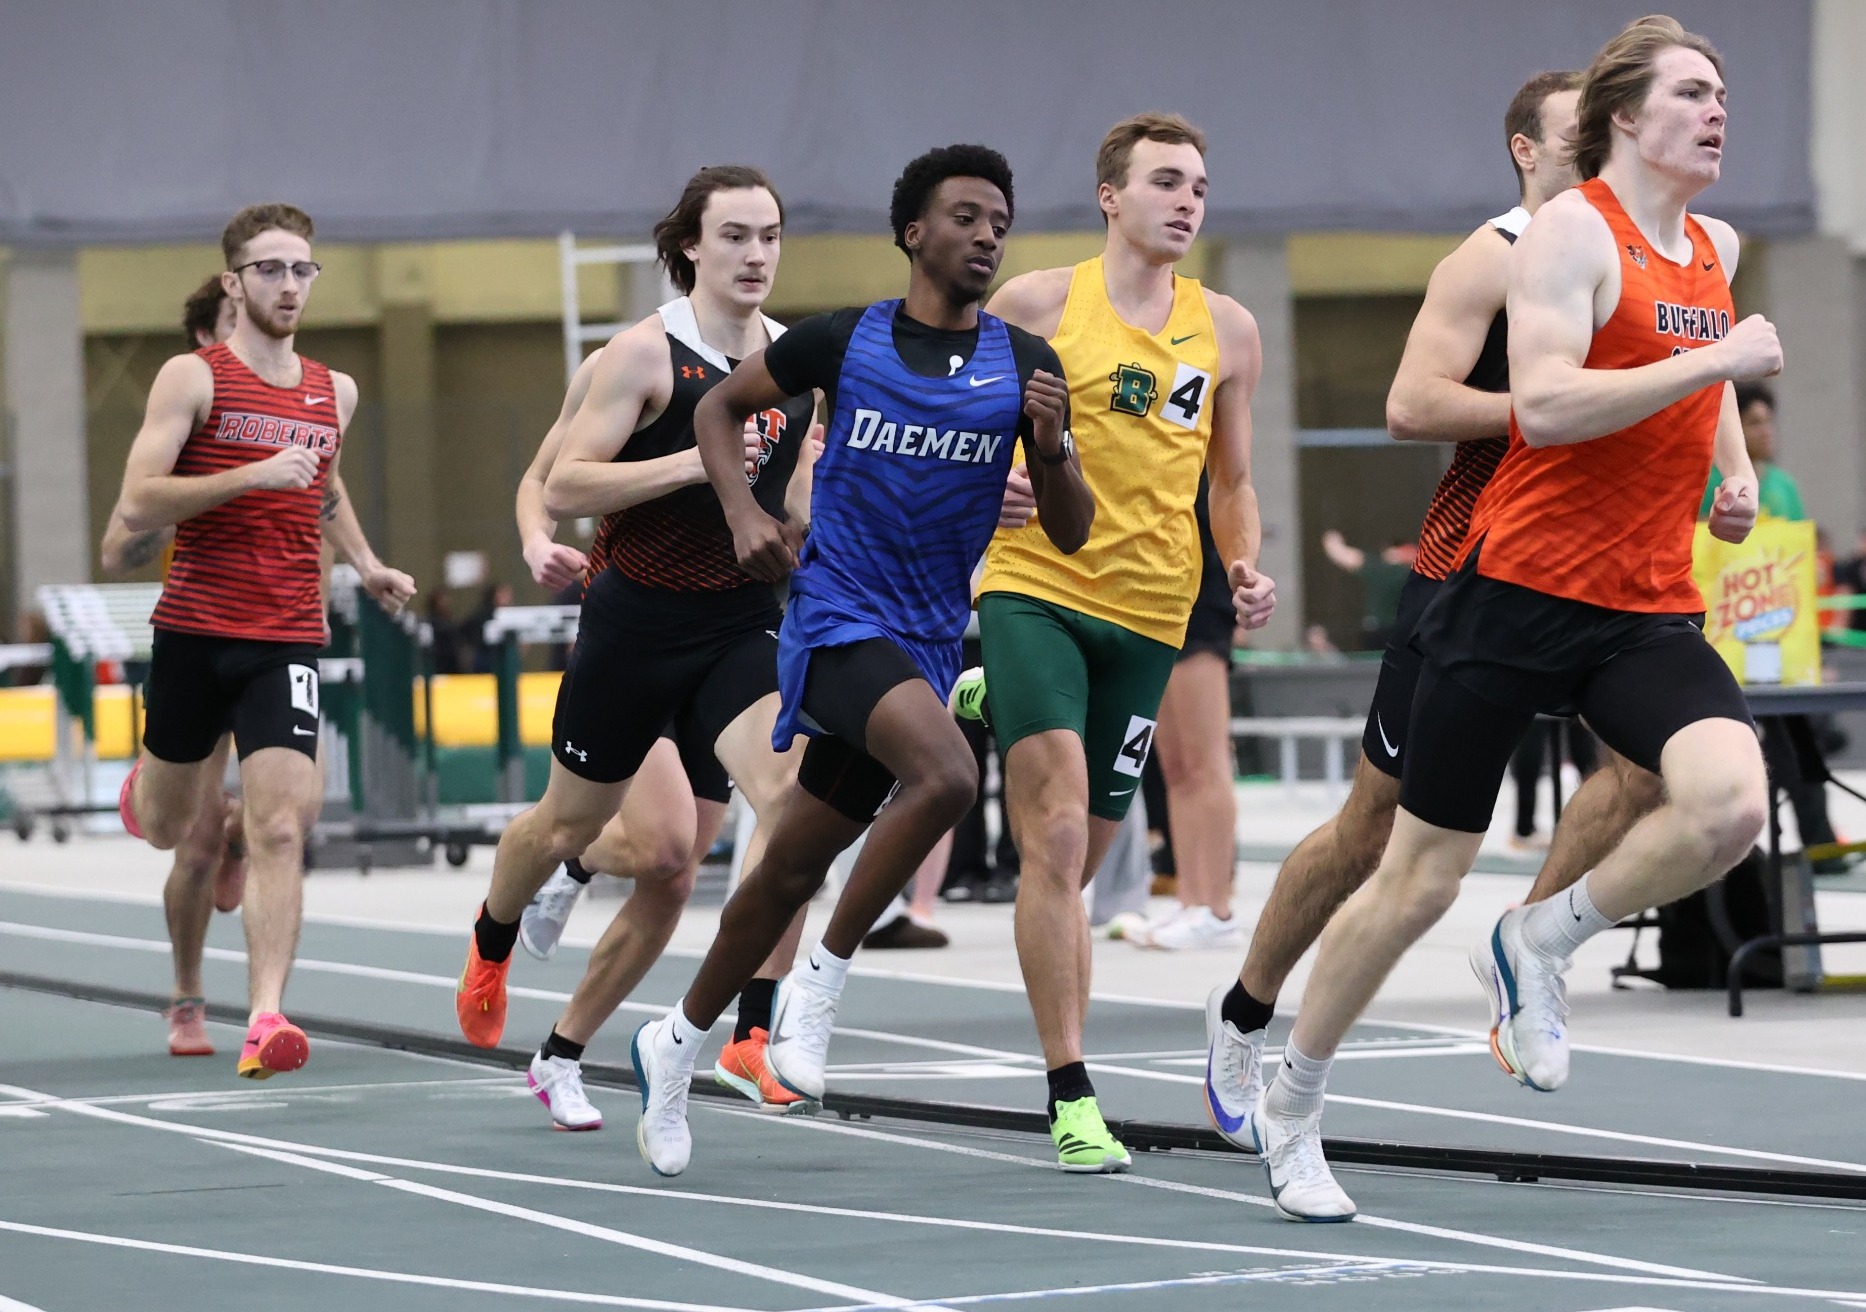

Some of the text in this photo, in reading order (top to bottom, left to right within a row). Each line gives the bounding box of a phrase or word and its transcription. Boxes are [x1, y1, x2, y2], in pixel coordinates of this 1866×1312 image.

[1654, 300, 1730, 342] BUFFALO
[1109, 363, 1157, 418] B
[1168, 375, 1205, 420] 4
[216, 412, 338, 456] ROBERTS
[846, 408, 1002, 464] DAEMEN
[1723, 562, 1775, 598] HOT
[1716, 585, 1792, 629] ZON
[1120, 724, 1152, 769] 4
